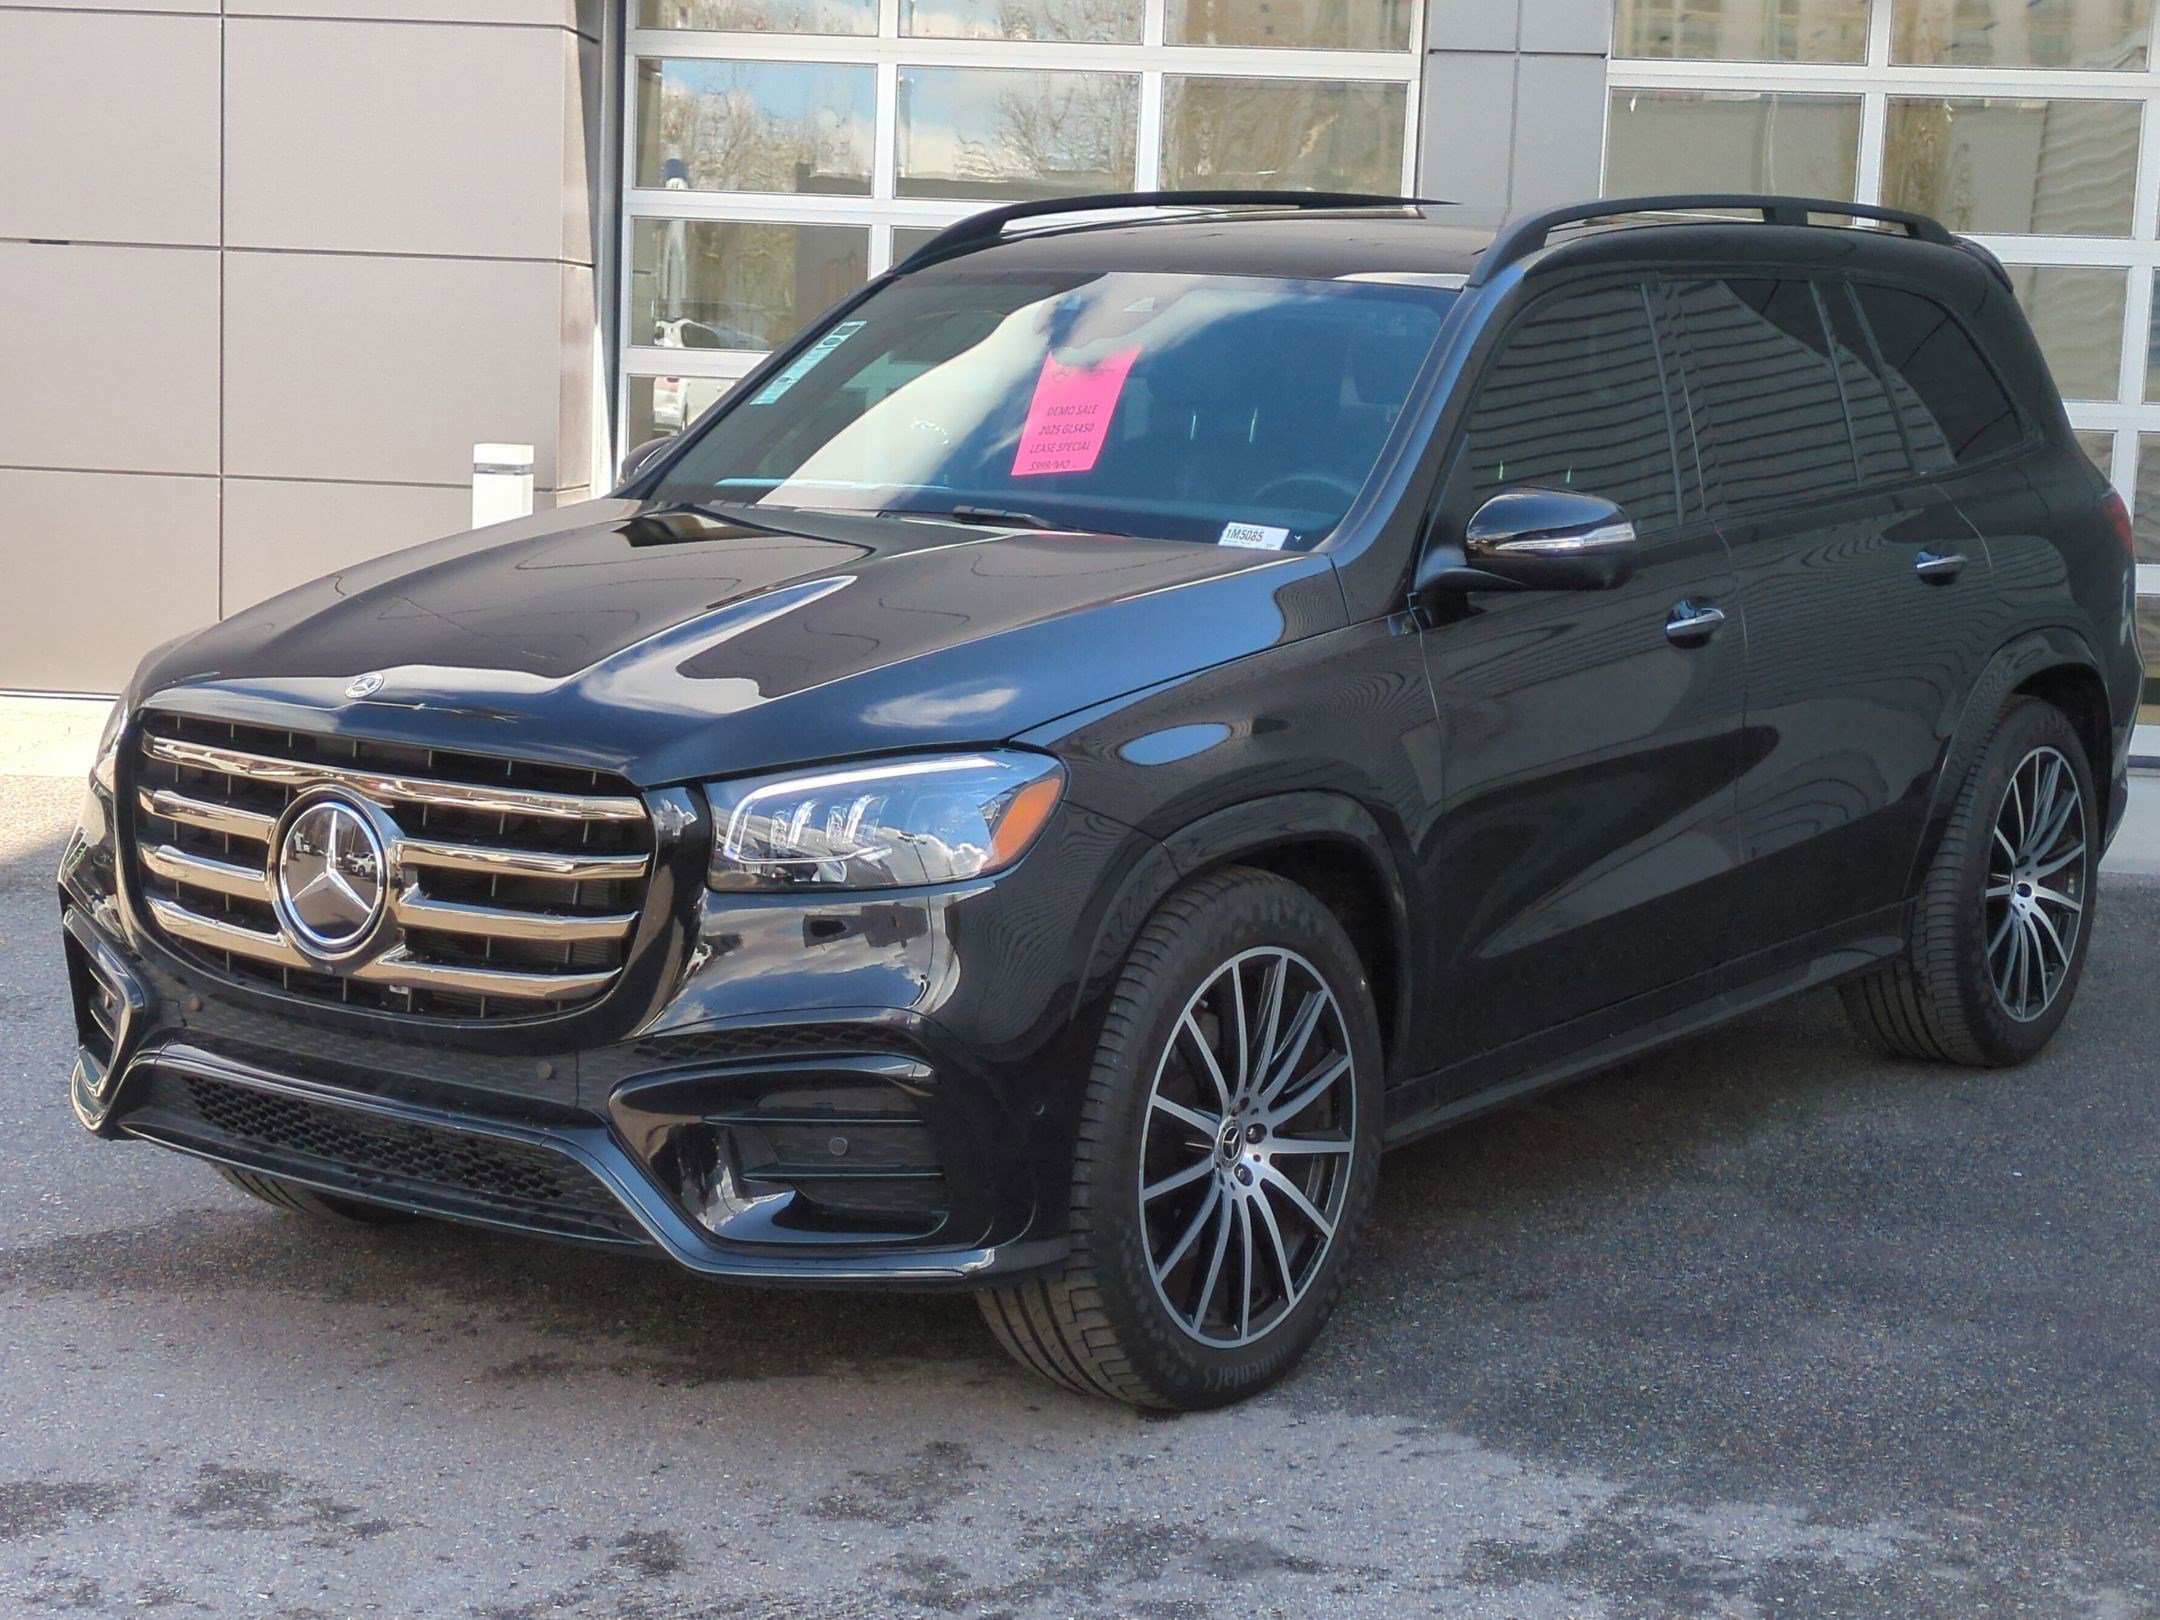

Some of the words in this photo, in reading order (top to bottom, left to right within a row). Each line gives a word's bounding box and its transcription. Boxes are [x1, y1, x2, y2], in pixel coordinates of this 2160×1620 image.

[1046, 406, 1075, 417] DEMO
[1076, 404, 1099, 415] SALE
[1030, 442, 1056, 454] LEASE
[1056, 440, 1091, 452] SPECIAL
[1226, 529, 1264, 542] 1M5085
